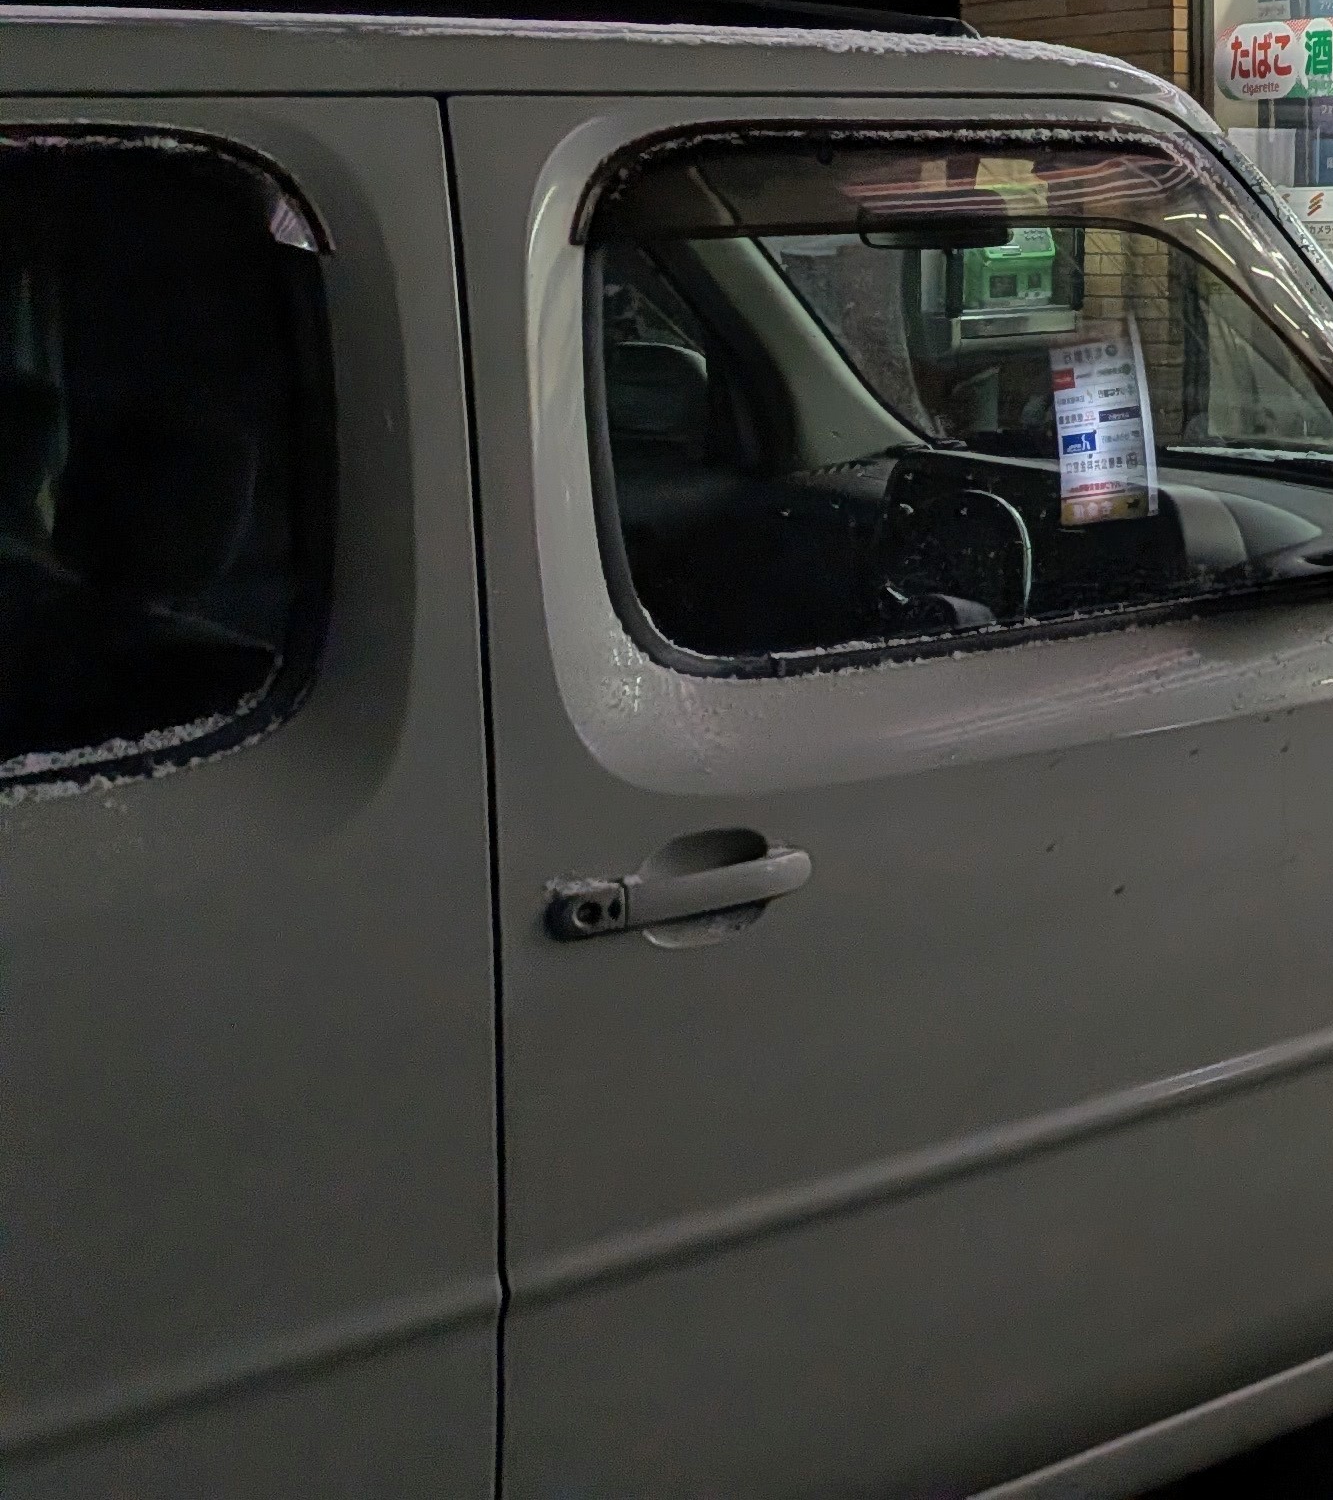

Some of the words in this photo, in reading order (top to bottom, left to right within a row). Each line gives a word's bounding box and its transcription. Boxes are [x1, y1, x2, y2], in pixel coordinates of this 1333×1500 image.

[1230, 32, 1292, 80] たばこ
[1304, 29, 1333, 75] 酒
